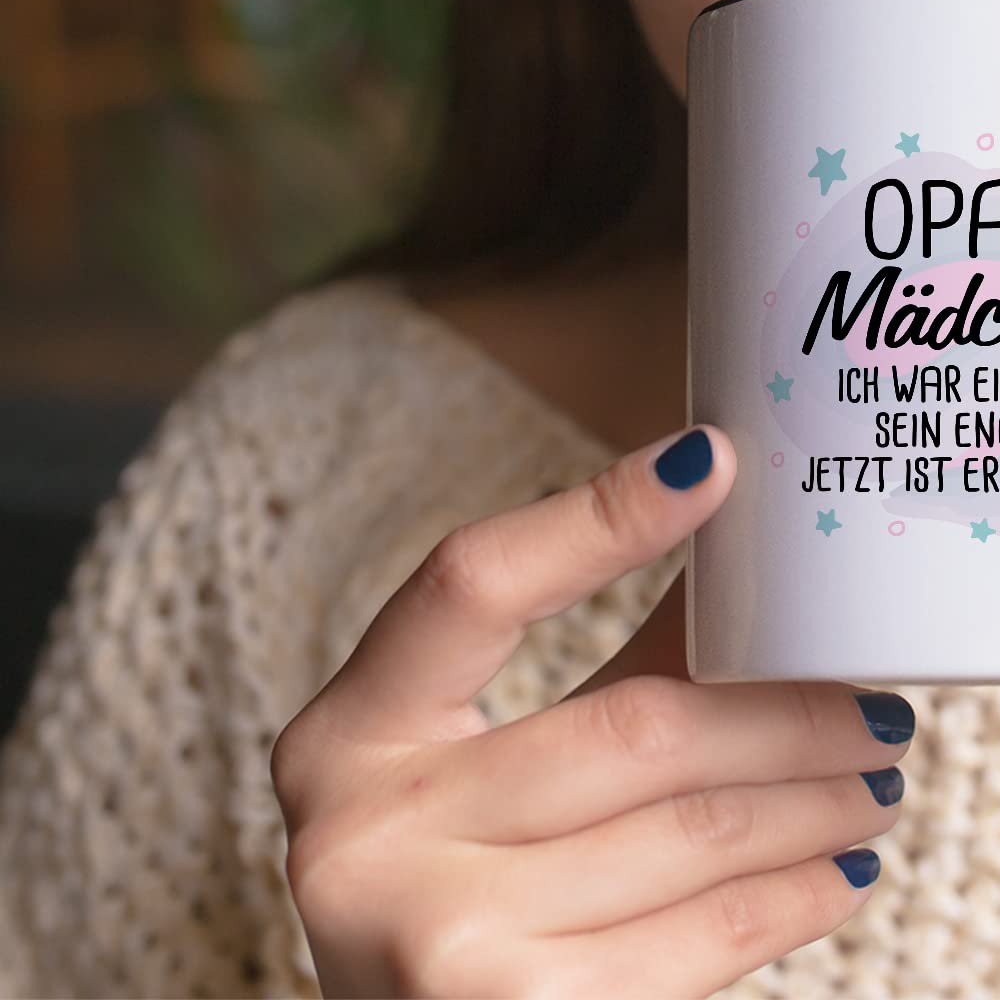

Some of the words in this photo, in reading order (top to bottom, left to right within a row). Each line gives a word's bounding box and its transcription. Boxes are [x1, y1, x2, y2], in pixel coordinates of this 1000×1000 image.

[838, 365, 880, 404] ICH
[891, 364, 962, 404] WAR
[875, 410, 941, 449] SEIN
[801, 456, 893, 493] JETZT
[905, 456, 953, 493] IST
[963, 455, 1000, 494] ER
